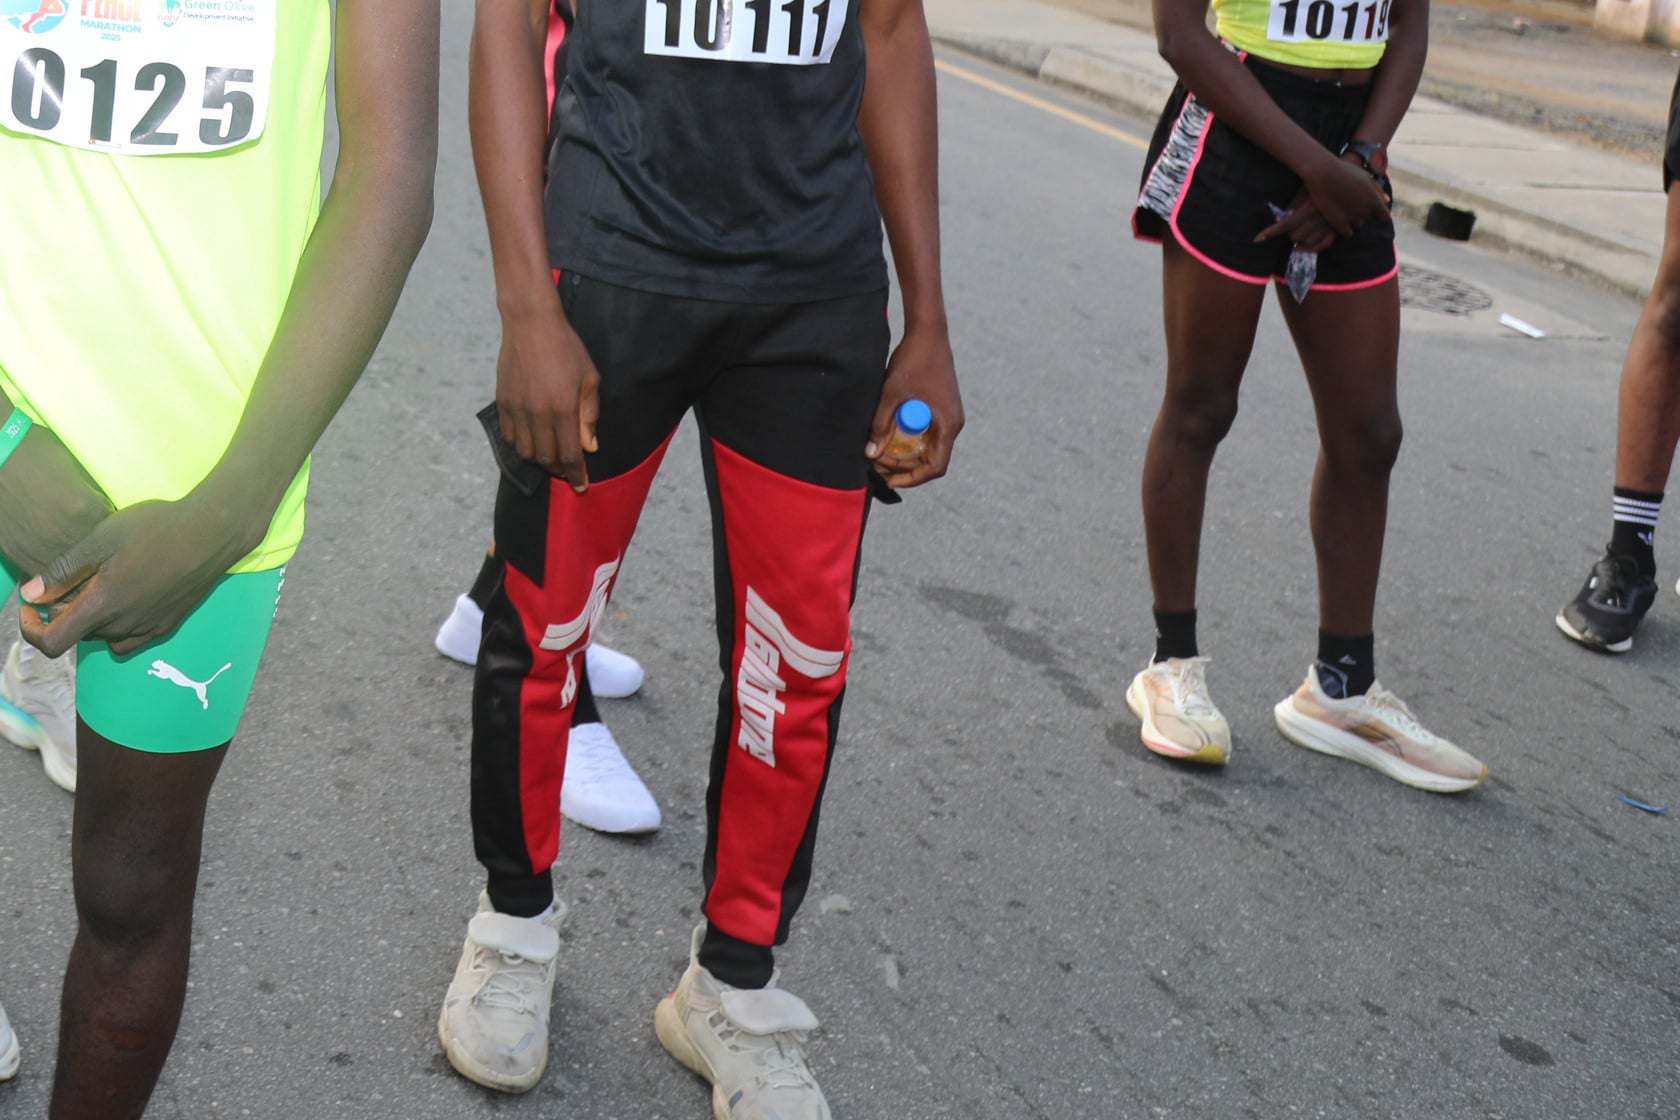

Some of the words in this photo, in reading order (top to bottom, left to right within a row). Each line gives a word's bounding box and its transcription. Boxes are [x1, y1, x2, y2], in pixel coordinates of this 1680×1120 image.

[183, 11, 226, 21] Development
[227, 14, 254, 22] Initiative
[80, 19, 142, 33] MARATHON
[100, 32, 122, 42] 2025
